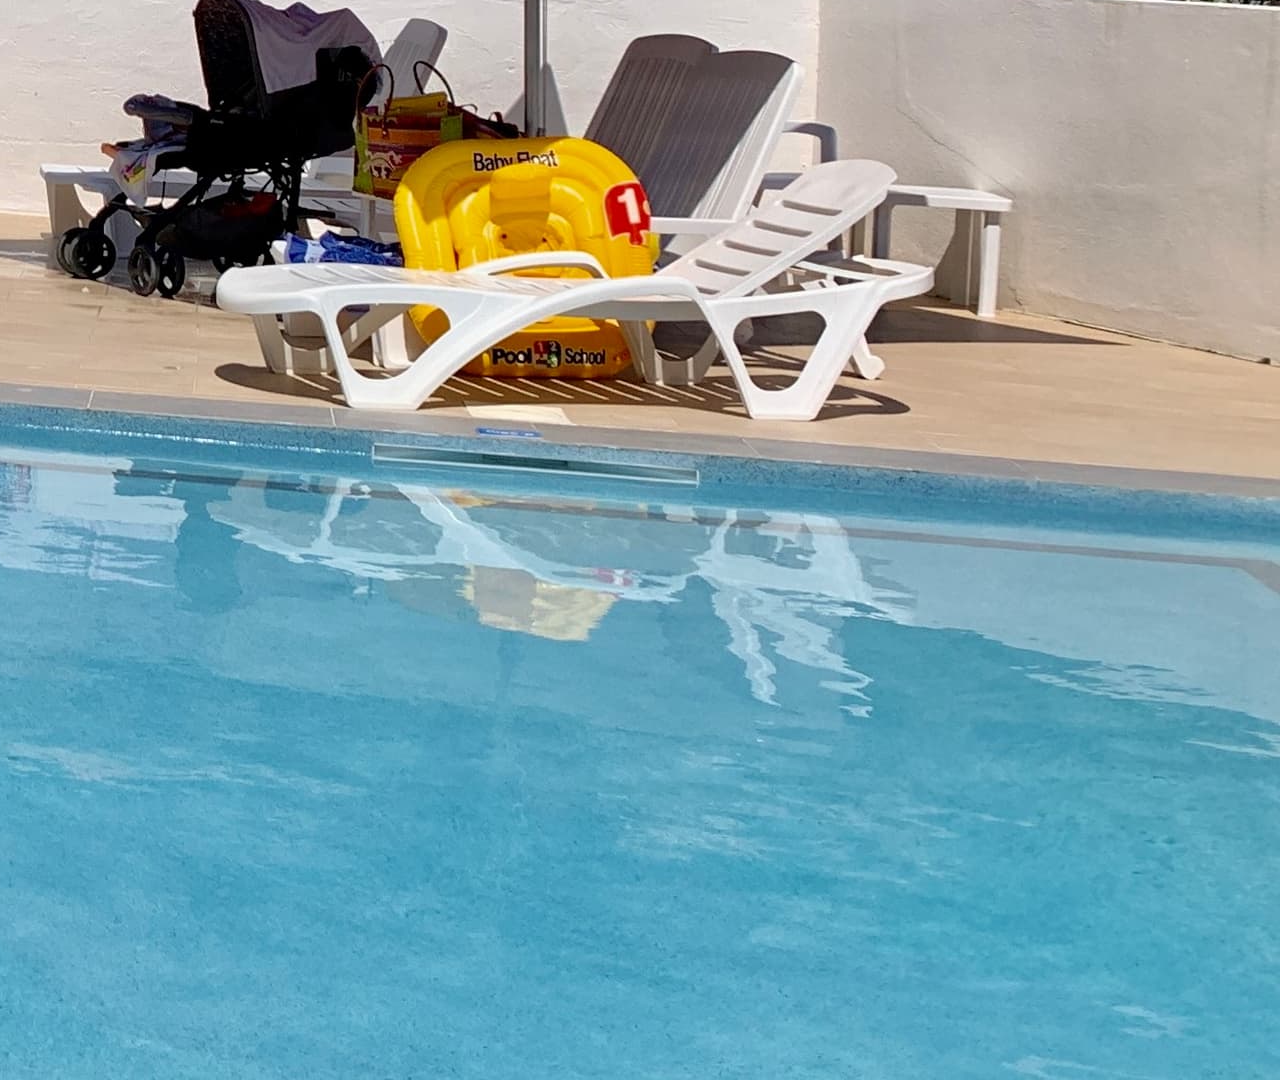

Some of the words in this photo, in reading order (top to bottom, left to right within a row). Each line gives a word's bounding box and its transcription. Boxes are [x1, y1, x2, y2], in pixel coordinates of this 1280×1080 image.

[617, 187, 641, 224] 1
[492, 348, 532, 364] Pool
[565, 348, 606, 365] School
